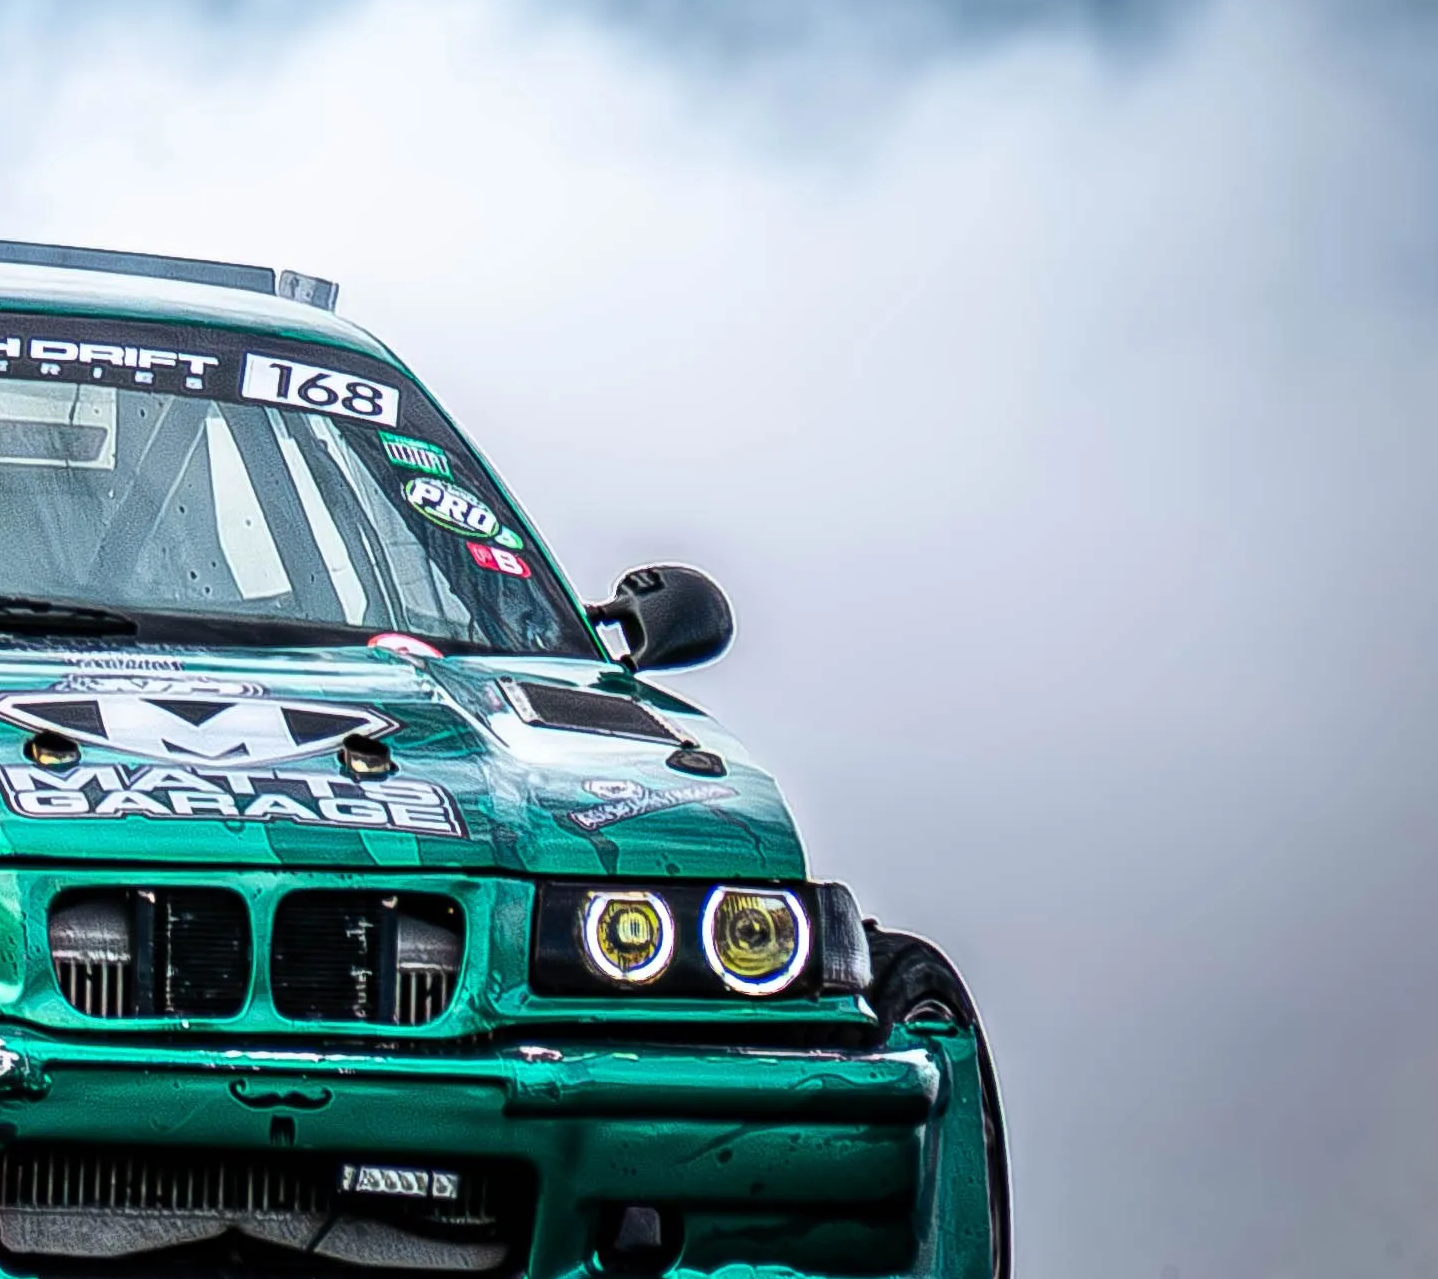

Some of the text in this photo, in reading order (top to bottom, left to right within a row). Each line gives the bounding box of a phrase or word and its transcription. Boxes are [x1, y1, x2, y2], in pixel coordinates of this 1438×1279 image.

[30, 339, 219, 375] DRIFT
[268, 361, 385, 416] 168
[409, 478, 498, 534] PRO
[0, 765, 441, 806] MATTS
[12, 789, 442, 830] GARAGE
